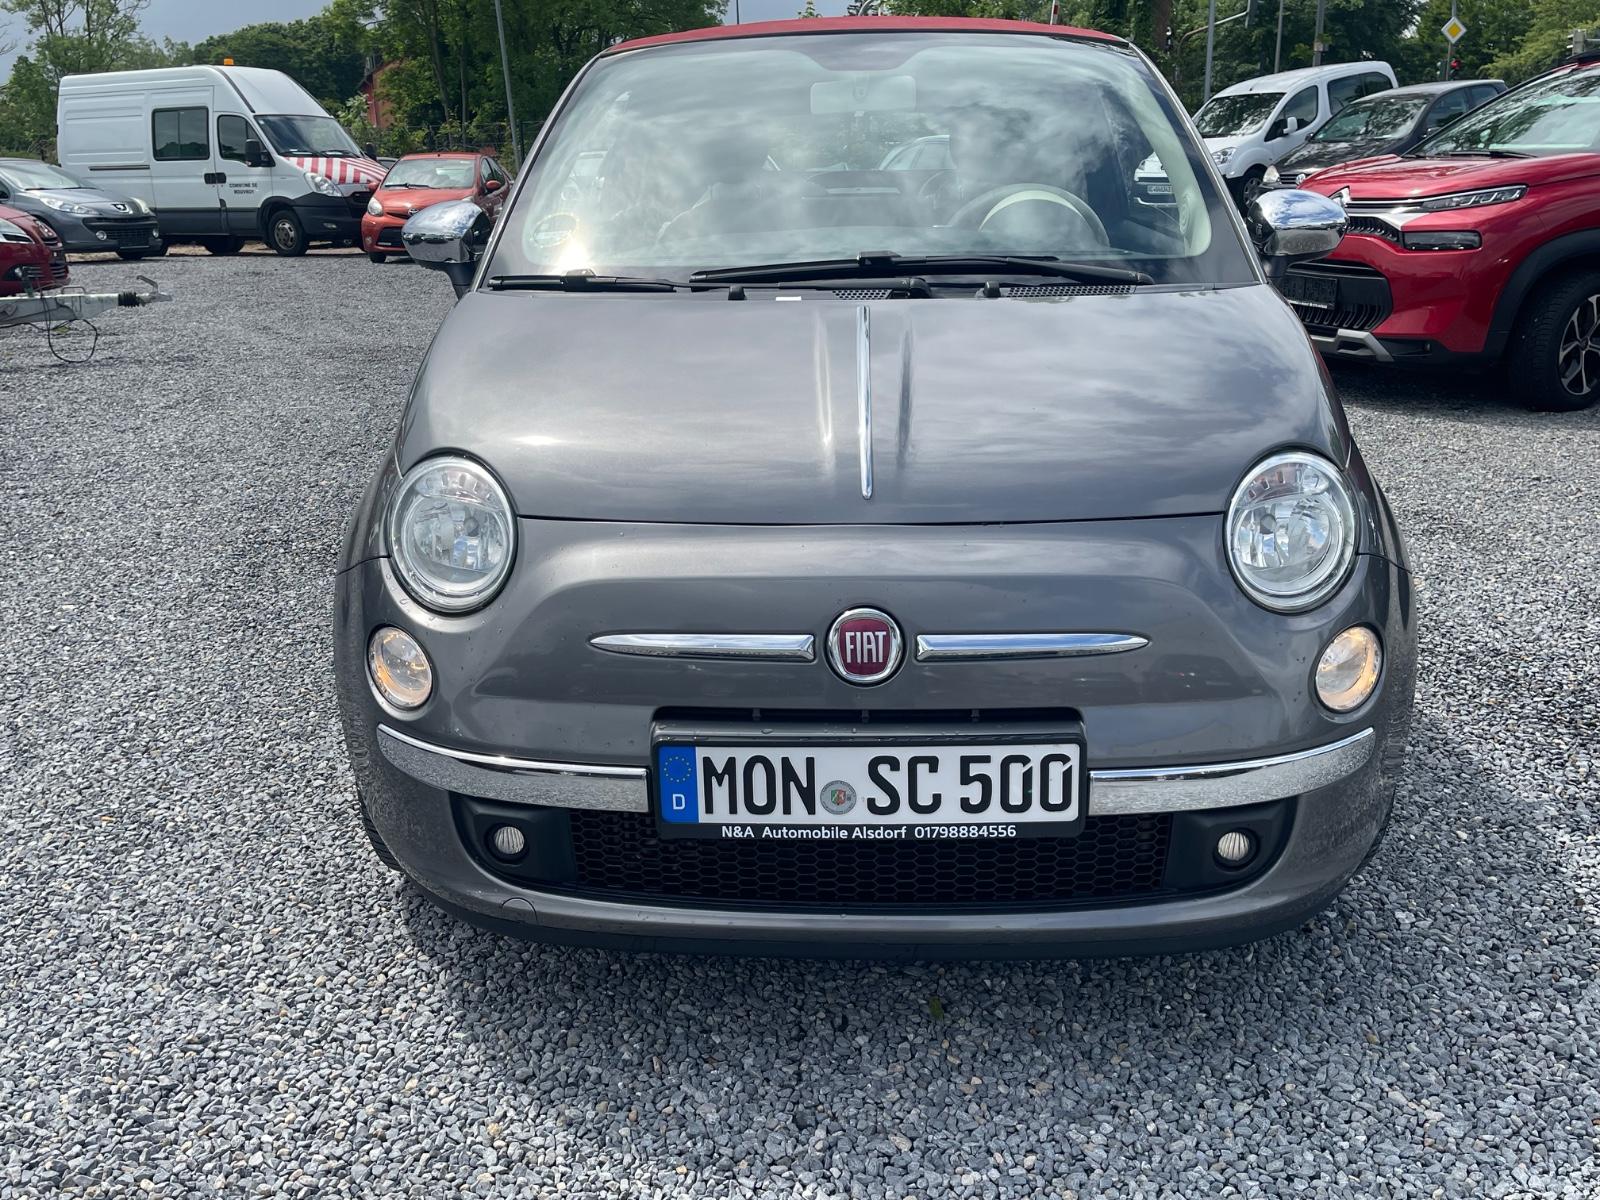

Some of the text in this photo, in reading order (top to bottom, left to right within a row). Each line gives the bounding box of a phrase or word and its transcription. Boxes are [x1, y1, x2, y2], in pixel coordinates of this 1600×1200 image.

[845, 631, 887, 664] FIAT
[702, 755, 816, 815] MON
[866, 755, 942, 816] SC
[959, 753, 1073, 814] 500
[672, 793, 686, 810] D
[721, 824, 1017, 840] N&A Automobile Alsdorf 01798884556
